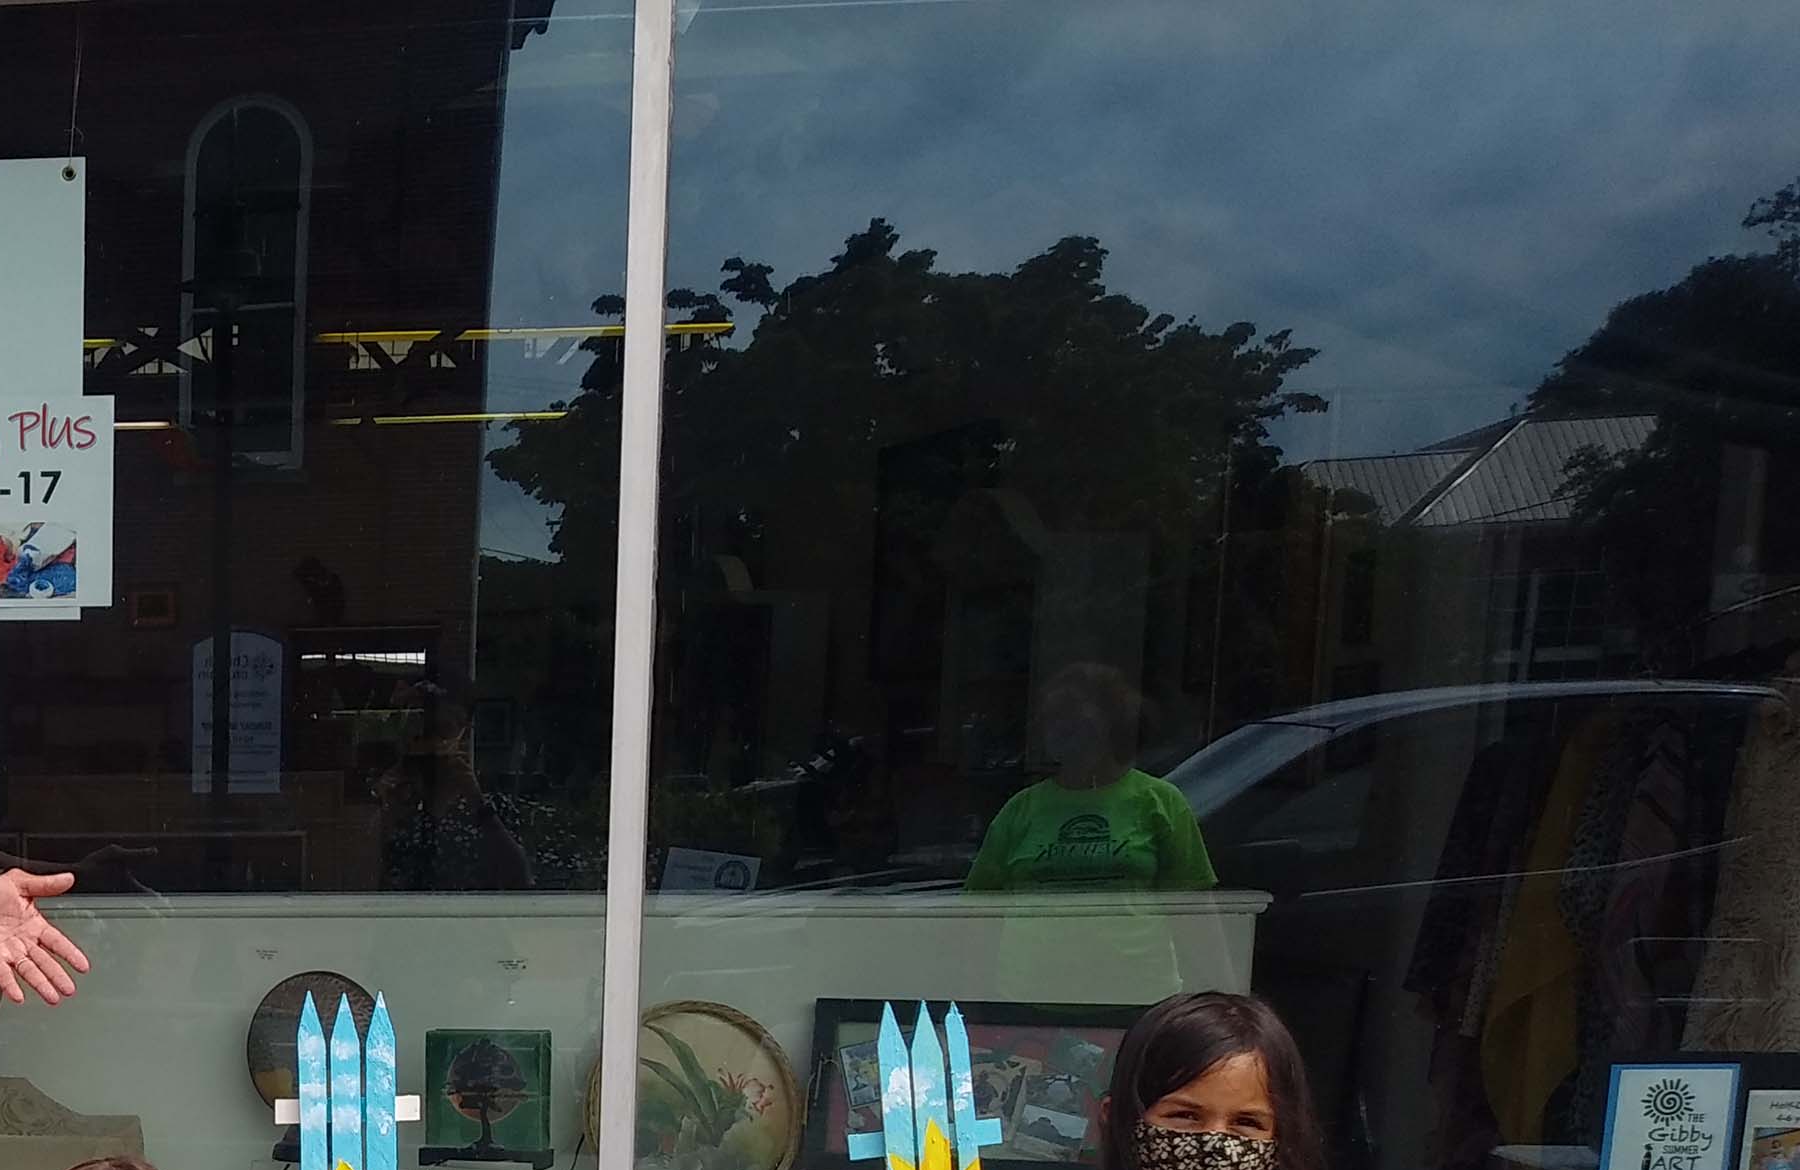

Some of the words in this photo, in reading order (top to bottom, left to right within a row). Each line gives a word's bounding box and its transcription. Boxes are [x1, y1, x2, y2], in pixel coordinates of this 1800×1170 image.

[8, 403, 96, 451] Plus
[1688, 1113, 1705, 1123] THE
[1648, 1125, 1713, 1151] Gibby
[1663, 1145, 1699, 1154] SUMMER
